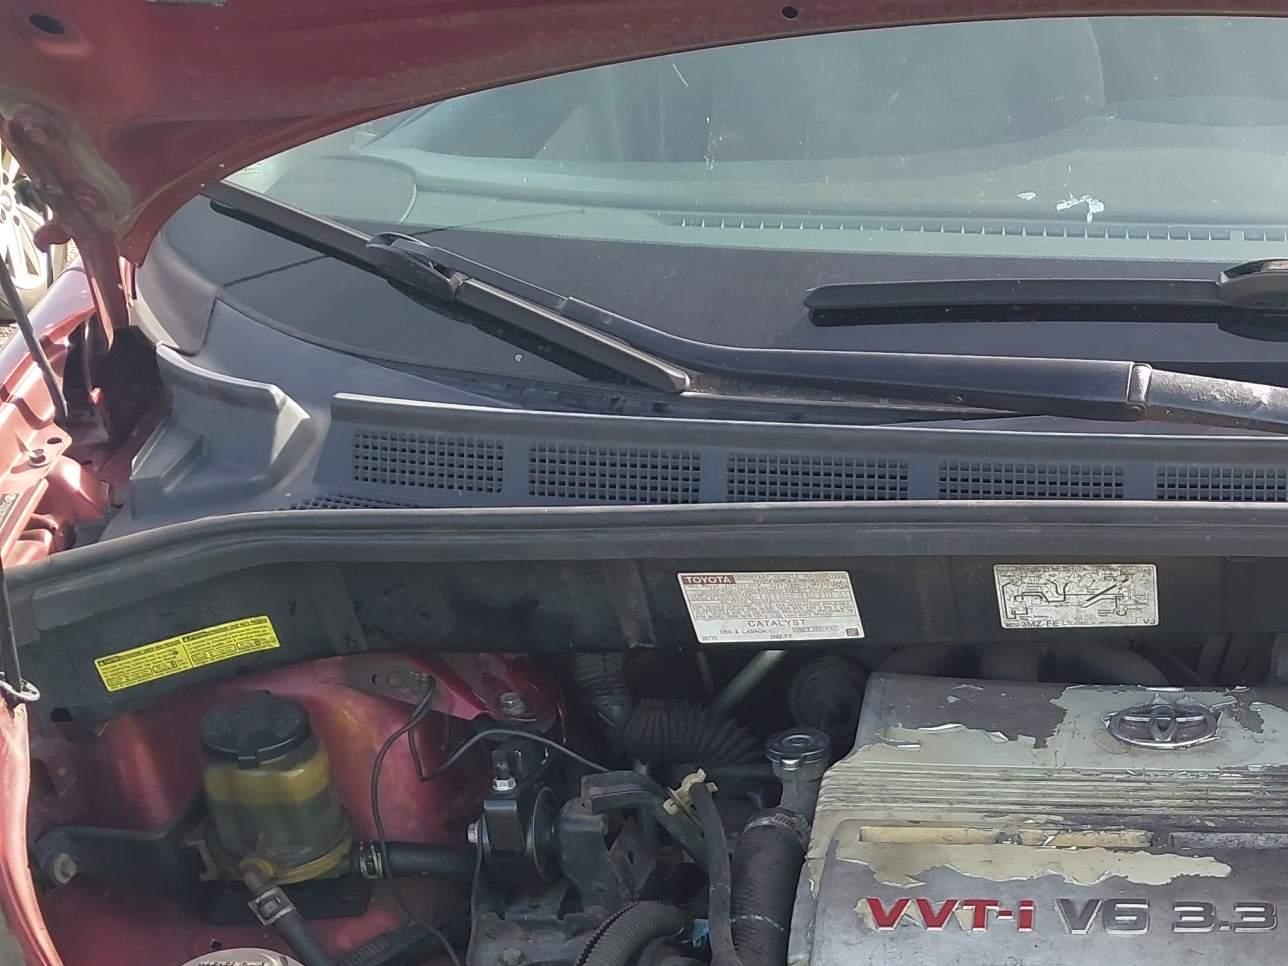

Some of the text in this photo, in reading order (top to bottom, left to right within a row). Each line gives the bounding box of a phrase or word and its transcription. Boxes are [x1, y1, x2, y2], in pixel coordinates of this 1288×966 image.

[685, 575, 732, 585] TOYOTA
[747, 619, 808, 628] CATALYST
[865, 896, 1279, 936] VVT-i V6 3.3
